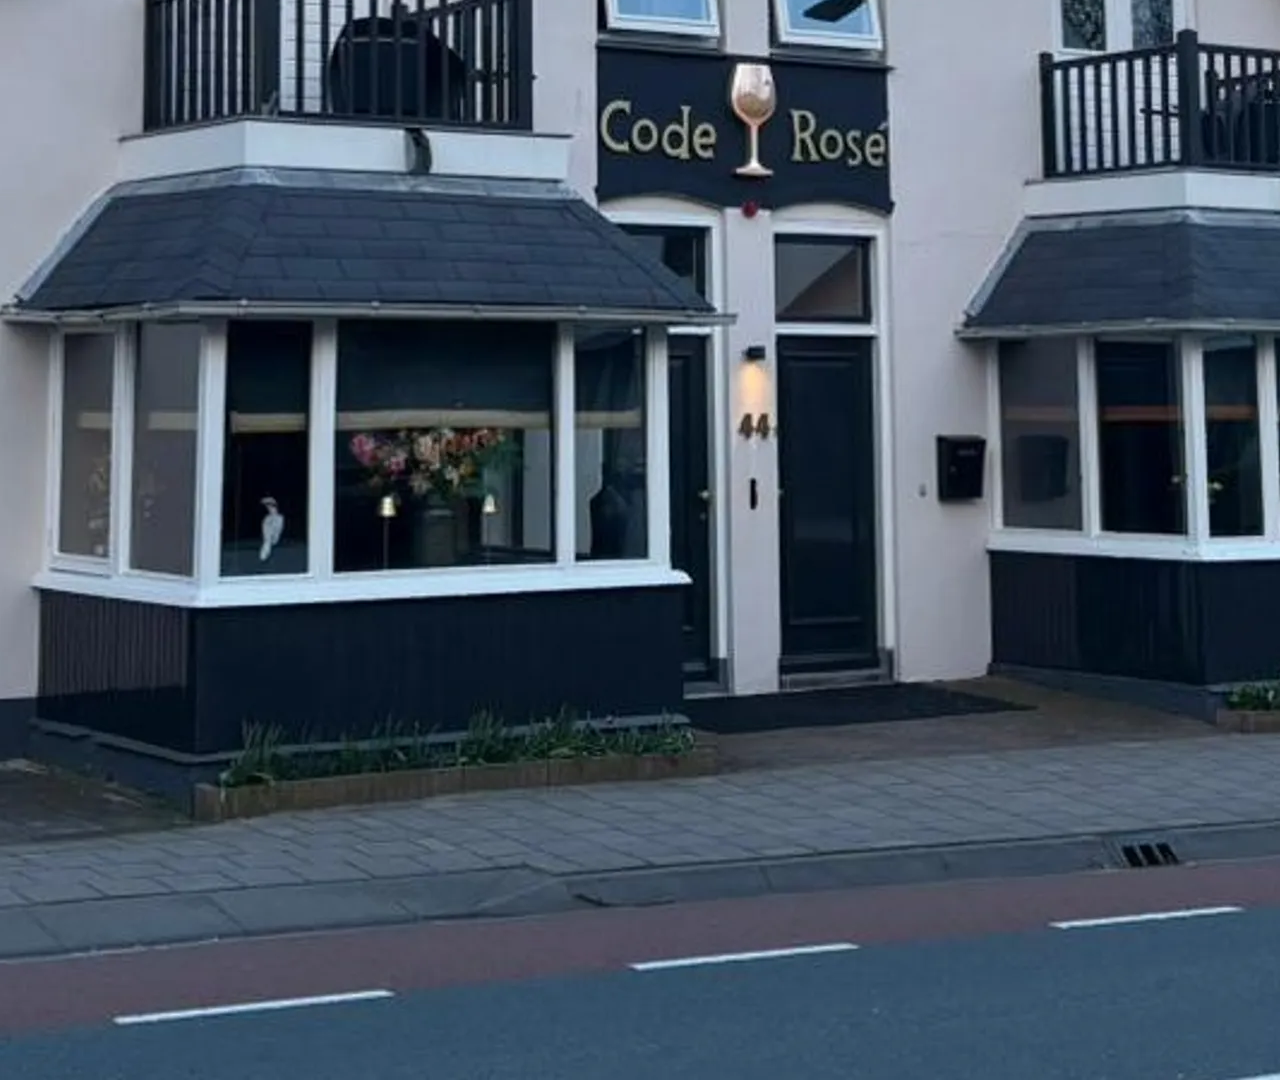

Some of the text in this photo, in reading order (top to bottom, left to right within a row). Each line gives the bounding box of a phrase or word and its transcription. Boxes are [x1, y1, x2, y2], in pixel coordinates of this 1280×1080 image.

[600, 100, 888, 167] Code Rosé
[738, 413, 770, 440] 44
